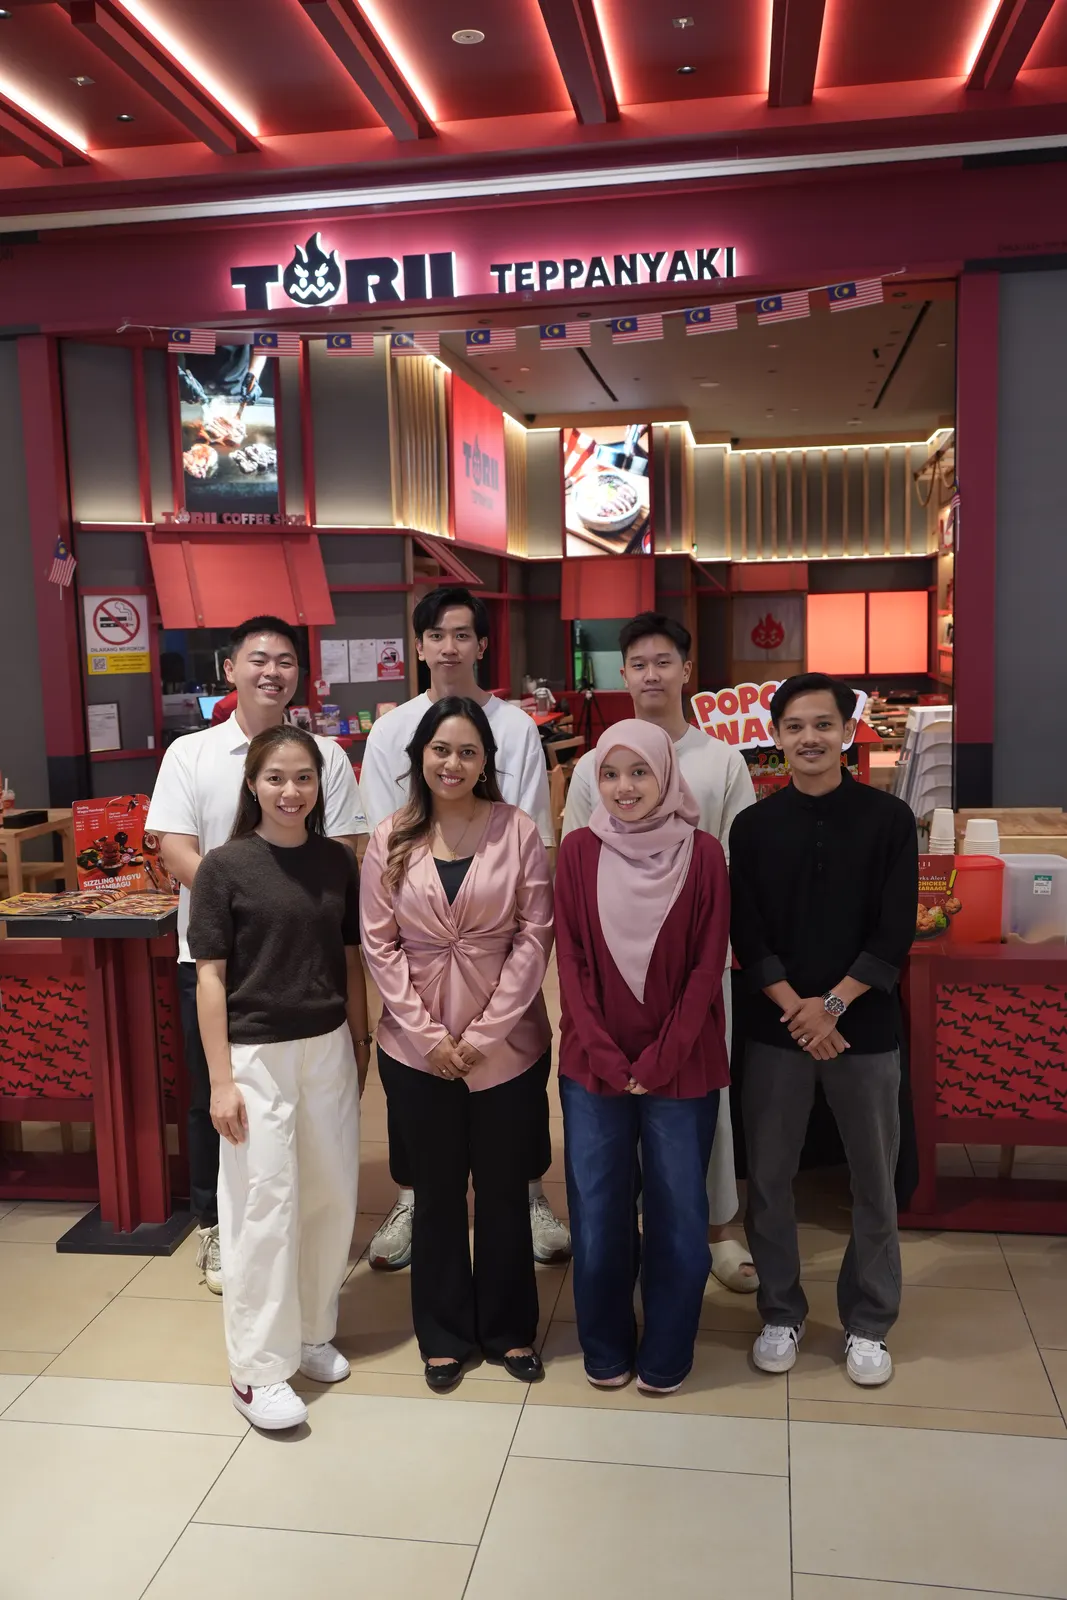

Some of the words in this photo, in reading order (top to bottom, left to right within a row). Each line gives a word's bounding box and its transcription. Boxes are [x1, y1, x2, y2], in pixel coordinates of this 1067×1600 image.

[230, 232, 458, 310] TORII
[490, 246, 737, 294] TEPPANYAKI
[222, 512, 271, 525] COFFEE
[83, 876, 114, 888] SIZZLING
[115, 873, 141, 883] WAGYU
